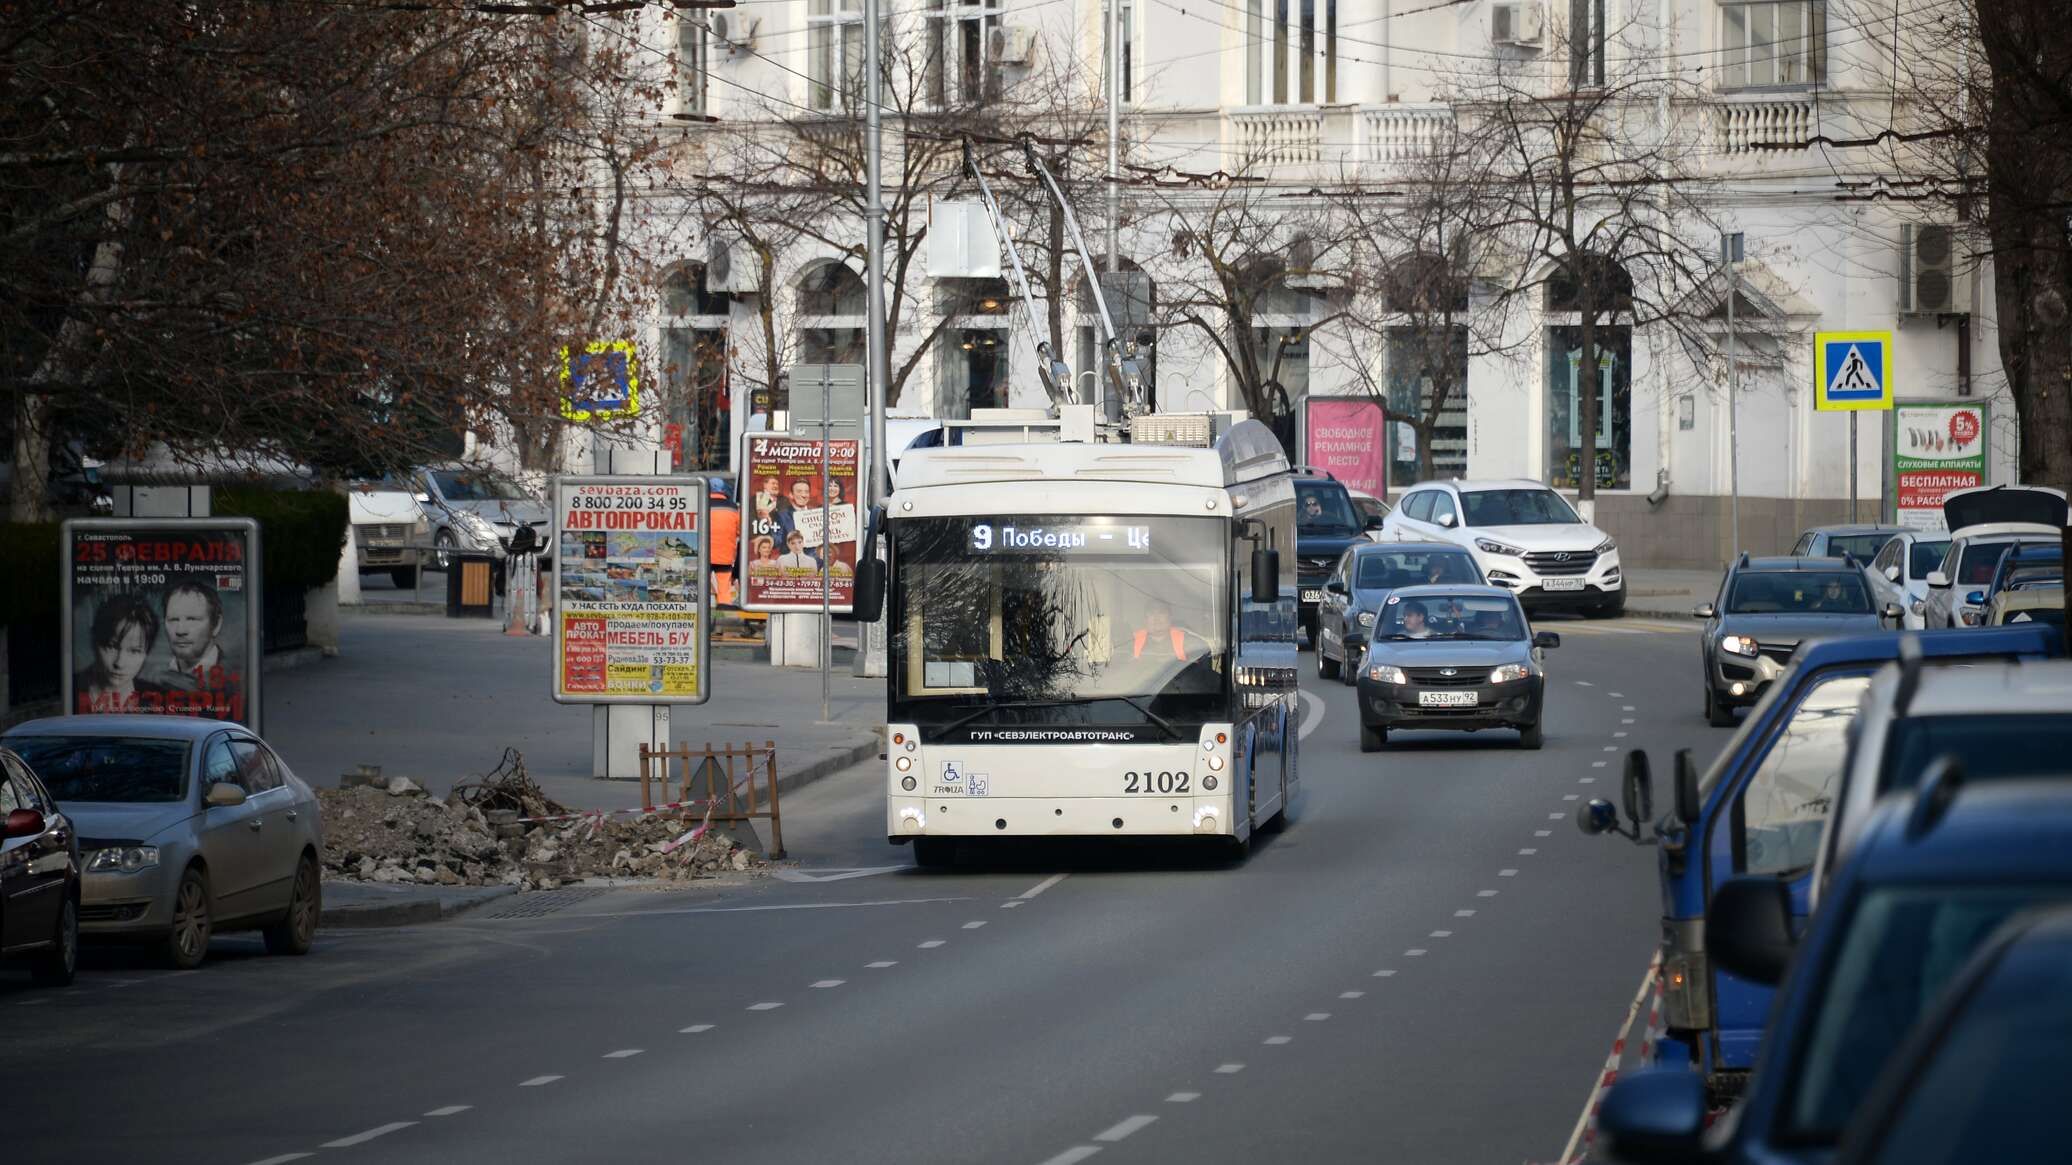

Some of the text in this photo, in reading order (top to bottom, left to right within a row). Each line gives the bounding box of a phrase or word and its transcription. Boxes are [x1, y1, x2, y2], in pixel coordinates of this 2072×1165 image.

[1315, 428, 1373, 440] СВОБОДНОЕ
[1315, 441, 1372, 453] РЕКЛАМНОЕ
[769, 447, 821, 459] марта
[825, 447, 855, 458] 9:00
[1328, 456, 1360, 466] МЕСТО
[1898, 460, 1981, 469] СЛУХОВЫЕ АППАРАТЫ
[1901, 475, 1976, 487] БЕСПЛАТНАЯ
[579, 486, 680, 496] sevbaza.com
[572, 496, 687, 510] 8 800 200 34 95
[1901, 496, 1915, 506] 0%
[566, 510, 698, 530] АВТОПРОКАТ
[752, 518, 781, 535] 16+
[973, 524, 992, 549] 9
[1003, 527, 1085, 548] Победы
[76, 543, 242, 561] 25 ФЕВРАЛЯ
[116, 563, 145, 572] Театра
[163, 564, 172, 572] А.
[184, 564, 242, 573] Луначарского
[77, 576, 120, 585] начало
[134, 574, 165, 585] 19:00
[571, 602, 688, 612] У НАС ЕСТЬ КУДА ПОЕХАТЬ!
[573, 622, 600, 631] АВТО
[607, 621, 695, 631] продаем/покупаем
[566, 630, 606, 639] ПРОКАТ
[607, 632, 690, 645] МЕБЕЛЬ Б/У
[608, 664, 647, 673] Сайдинг
[194, 664, 240, 689] 18+
[1423, 693, 1462, 704] А533НУ
[655, 712, 669, 721] 95
[970, 731, 1135, 741] ГУП «СЕВЭЛЕКТРОАВТОТРАНС»
[1124, 771, 1190, 794] 2102
